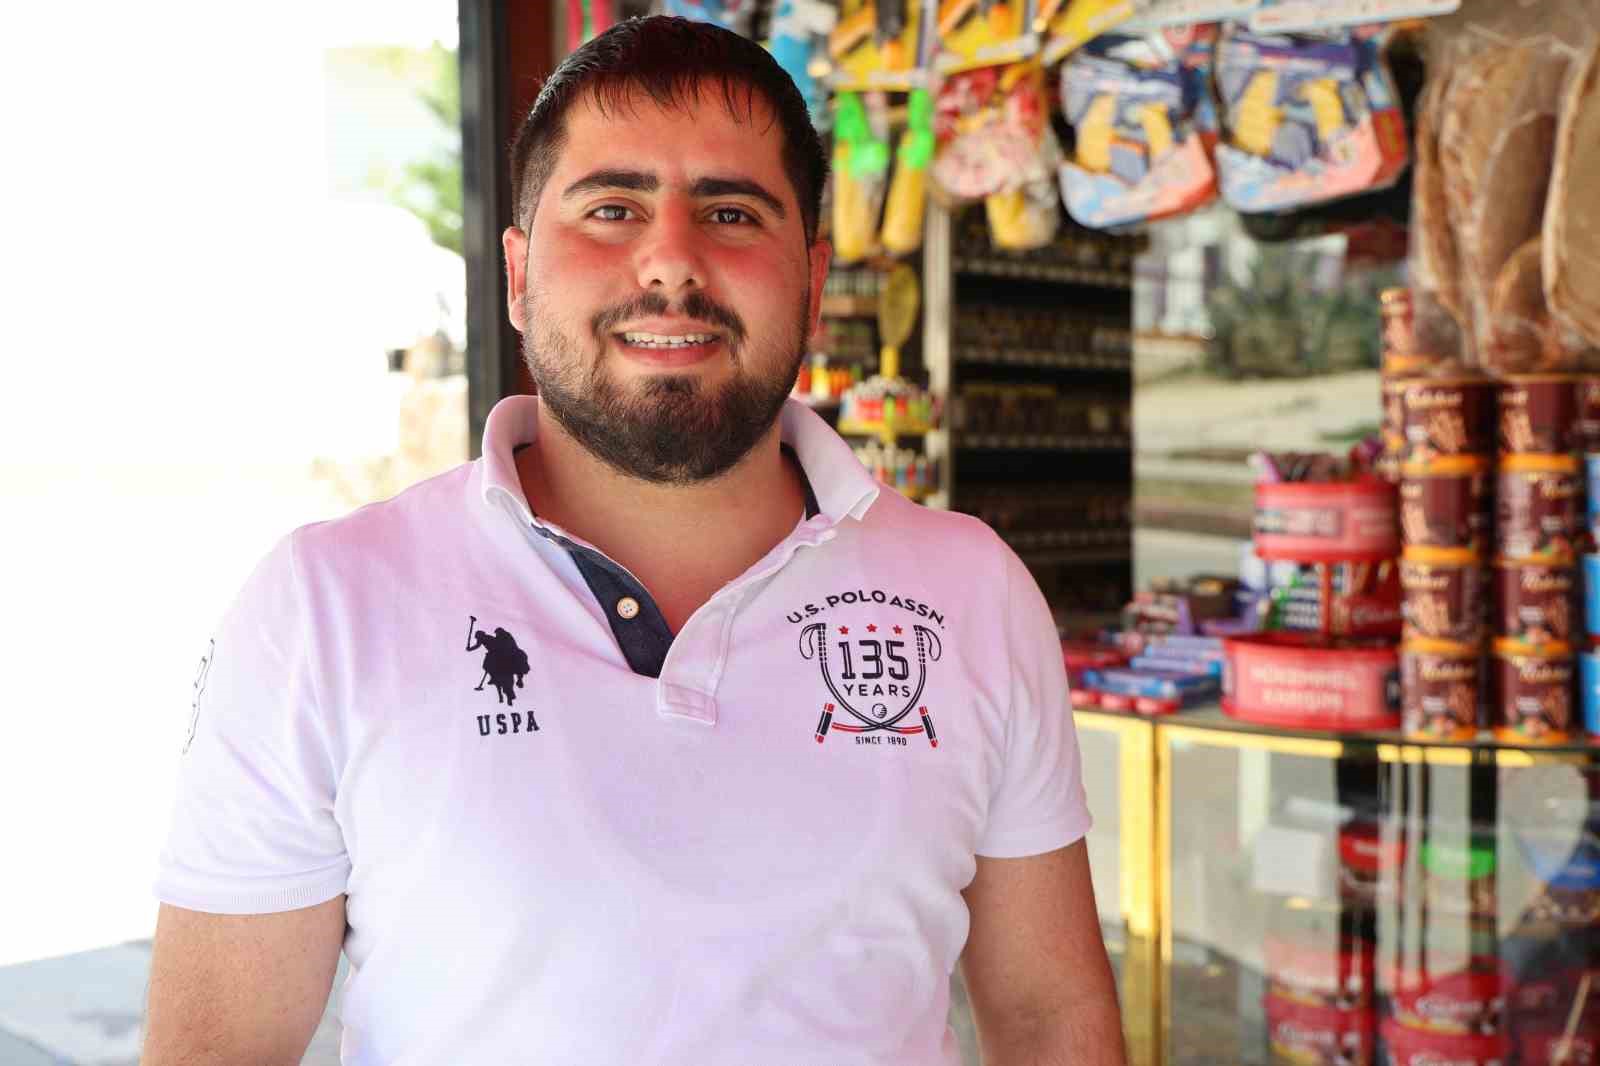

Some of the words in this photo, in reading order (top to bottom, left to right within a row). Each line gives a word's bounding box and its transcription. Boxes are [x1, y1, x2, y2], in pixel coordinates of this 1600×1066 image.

[786, 605, 825, 624] U.S.
[825, 590, 886, 608] POLO
[889, 596, 945, 629] ASSN.
[838, 639, 909, 680] 135
[843, 684, 911, 698] YEARS
[476, 710, 540, 736] USPA
[855, 736, 881, 745] SINCE
[887, 736, 907, 746] 1890
